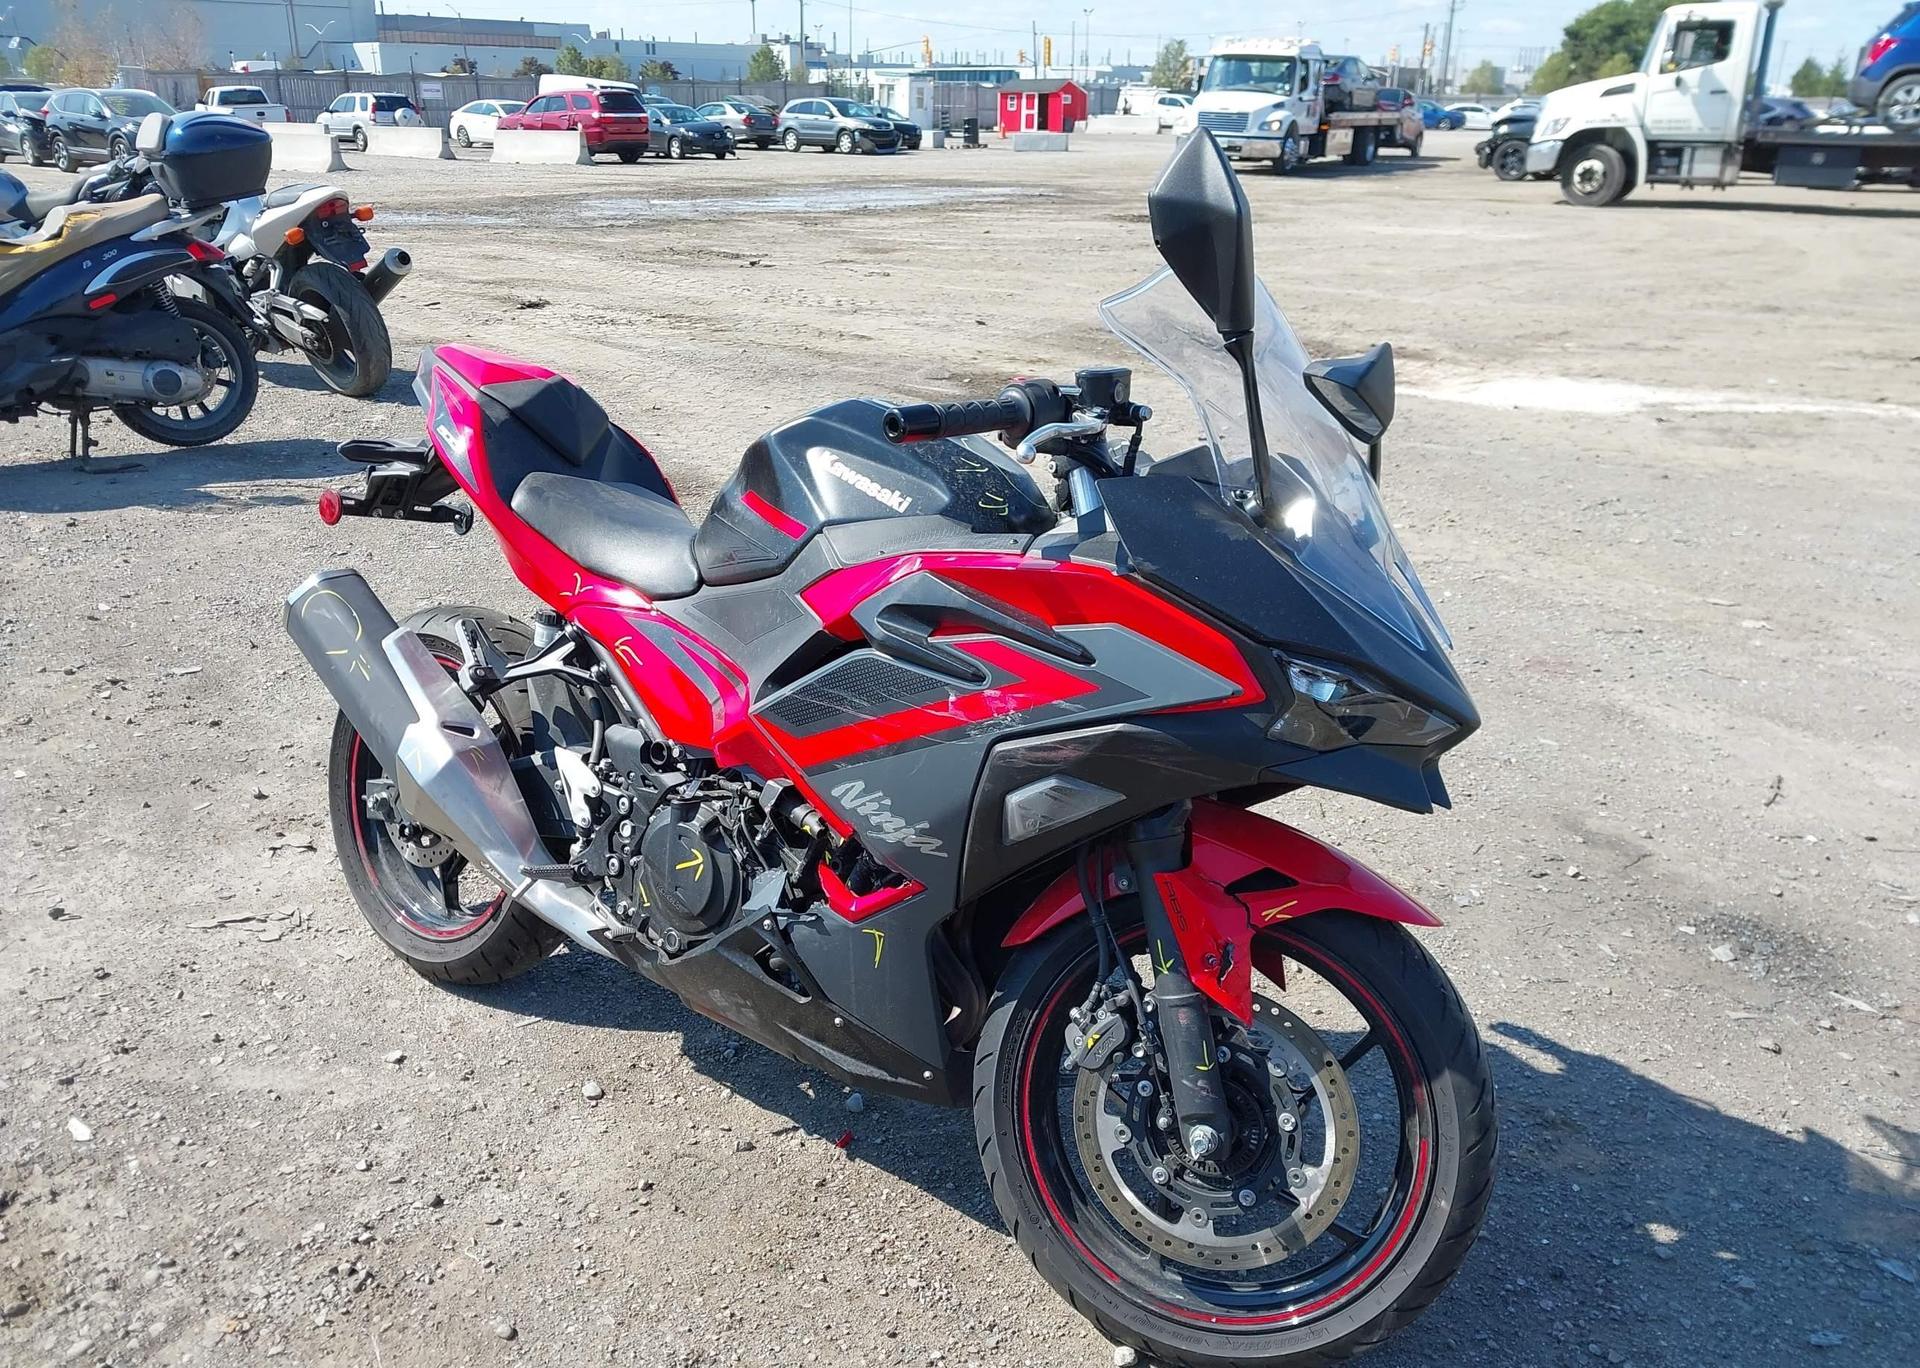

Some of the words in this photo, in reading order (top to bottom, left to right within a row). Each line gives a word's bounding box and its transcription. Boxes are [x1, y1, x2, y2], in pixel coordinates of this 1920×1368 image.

[820, 450, 913, 514] Kawasaki
[831, 780, 949, 858] Ninja
[1163, 880, 1190, 933] ABS
